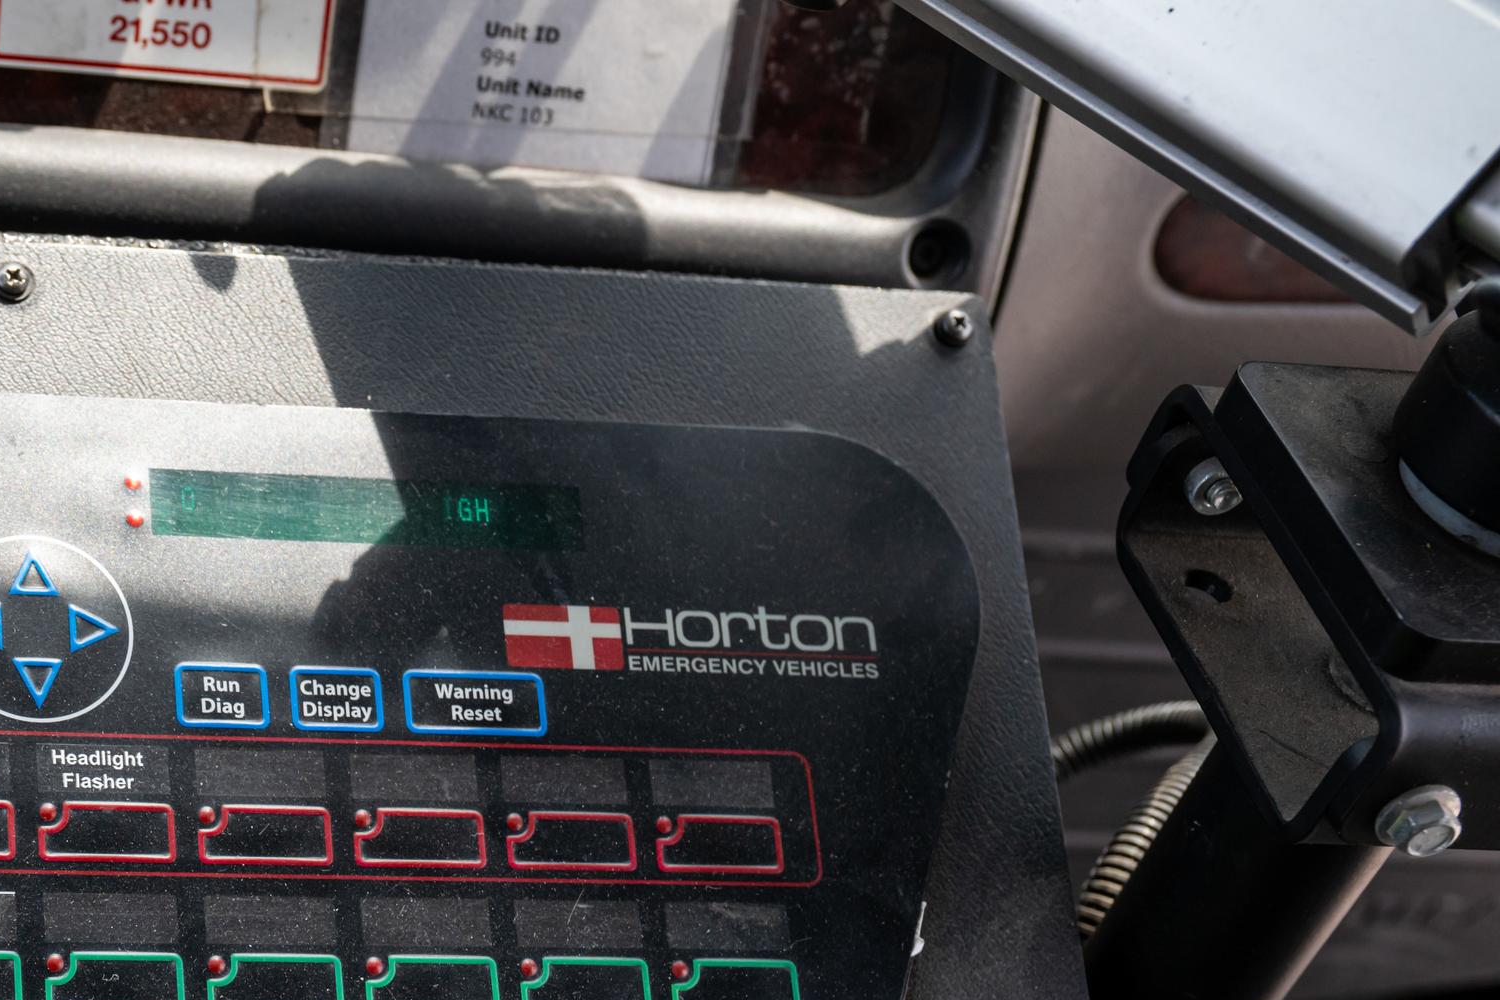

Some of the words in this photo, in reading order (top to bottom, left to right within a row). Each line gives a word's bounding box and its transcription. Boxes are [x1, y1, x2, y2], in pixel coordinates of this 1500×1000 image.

[110, 15, 213, 49] 21,550
[485, 21, 527, 41] Unit
[534, 25, 560, 44] ID
[481, 48, 516, 67] 994
[477, 76, 519, 96] Unit
[525, 80, 585, 101] Name
[472, 103, 513, 123] NKC
[520, 106, 555, 126] 103
[623, 606, 878, 652] Horton
[628, 655, 768, 676] EMERGENCY
[773, 659, 879, 679] VEHICLES
[203, 676, 240, 693] Run
[299, 680, 371, 701] Change
[434, 683, 513, 704] Warning
[201, 697, 245, 718] Diag
[303, 702, 372, 723] Display
[451, 705, 503, 723] Reset
[51, 749, 144, 769] Headlight
[62, 772, 134, 790] Flasher
